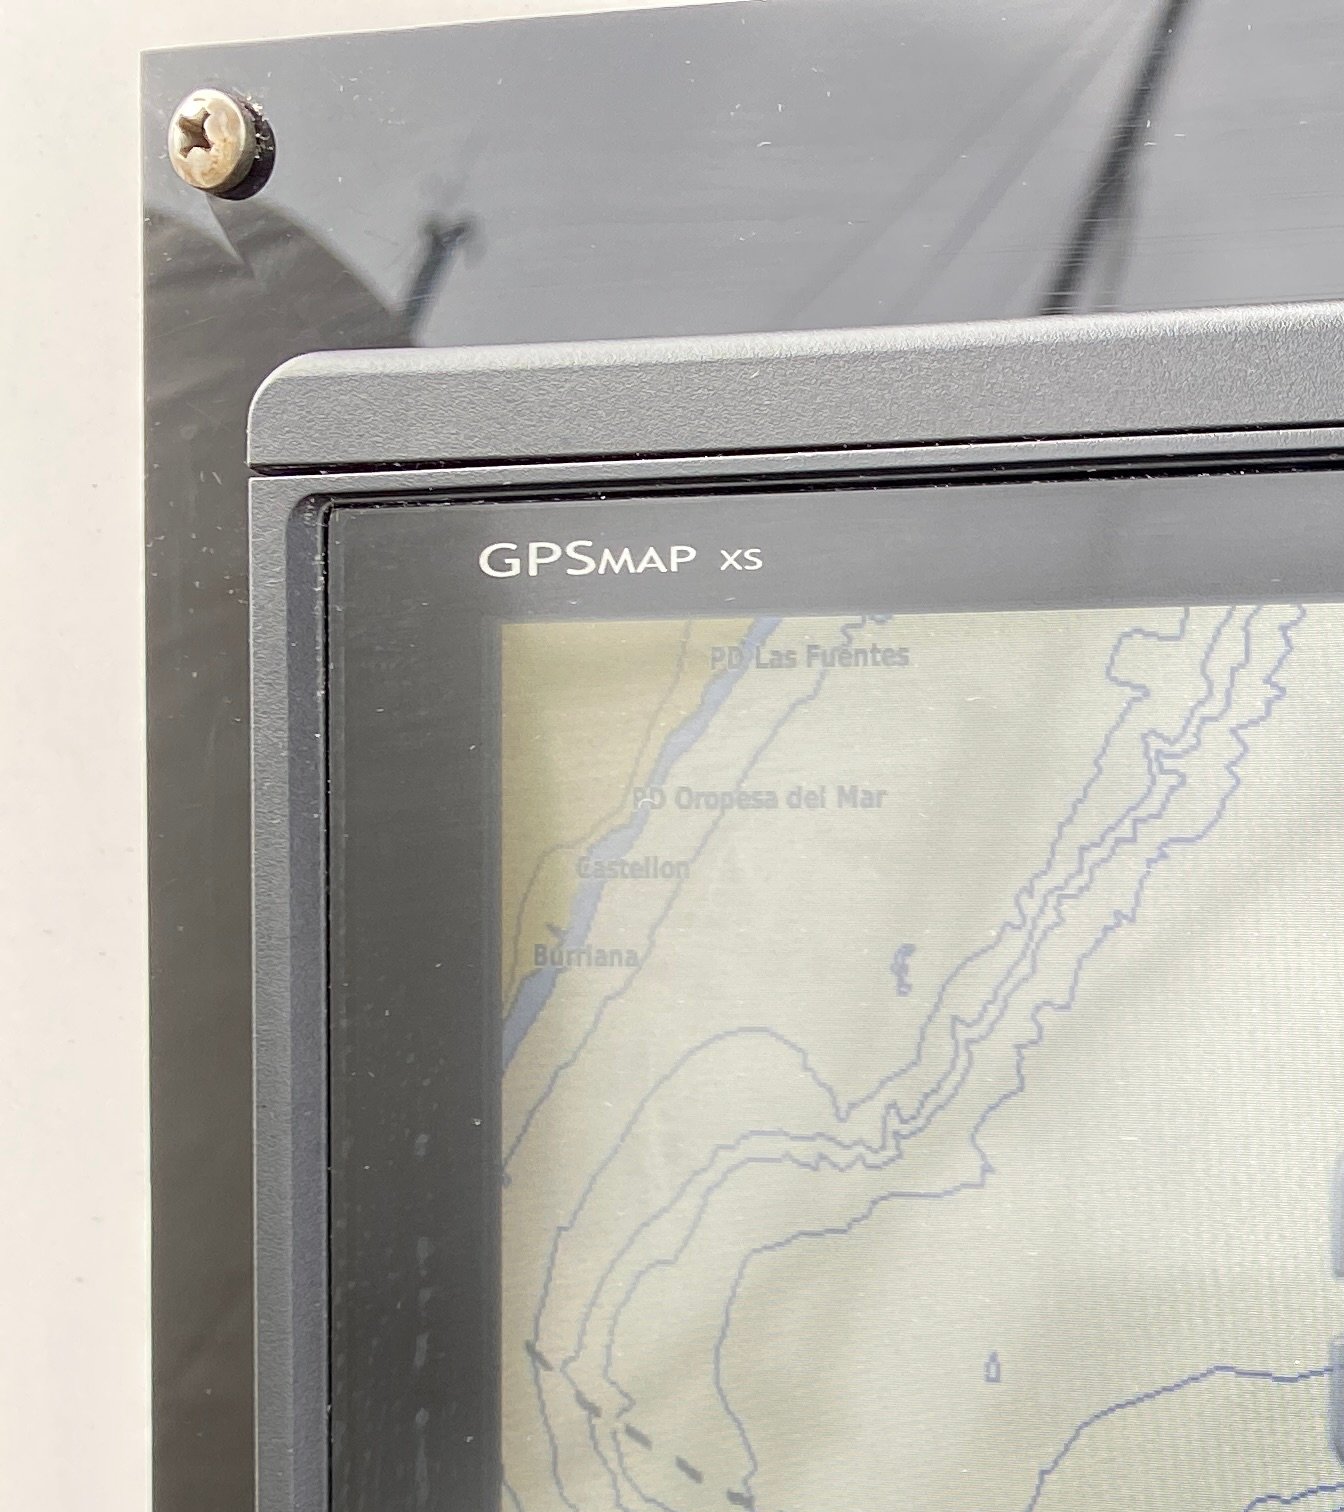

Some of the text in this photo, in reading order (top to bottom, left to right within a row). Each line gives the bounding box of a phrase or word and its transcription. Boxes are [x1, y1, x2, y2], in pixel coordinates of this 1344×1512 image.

[477, 540, 697, 578] GPSMAP
[710, 644, 910, 670] PD Las Fuentes
[674, 786, 779, 813] Oropesa
[785, 784, 826, 808] del
[836, 784, 888, 808] Mar
[576, 855, 690, 880] Castellon
[534, 943, 640, 968] Burriana
